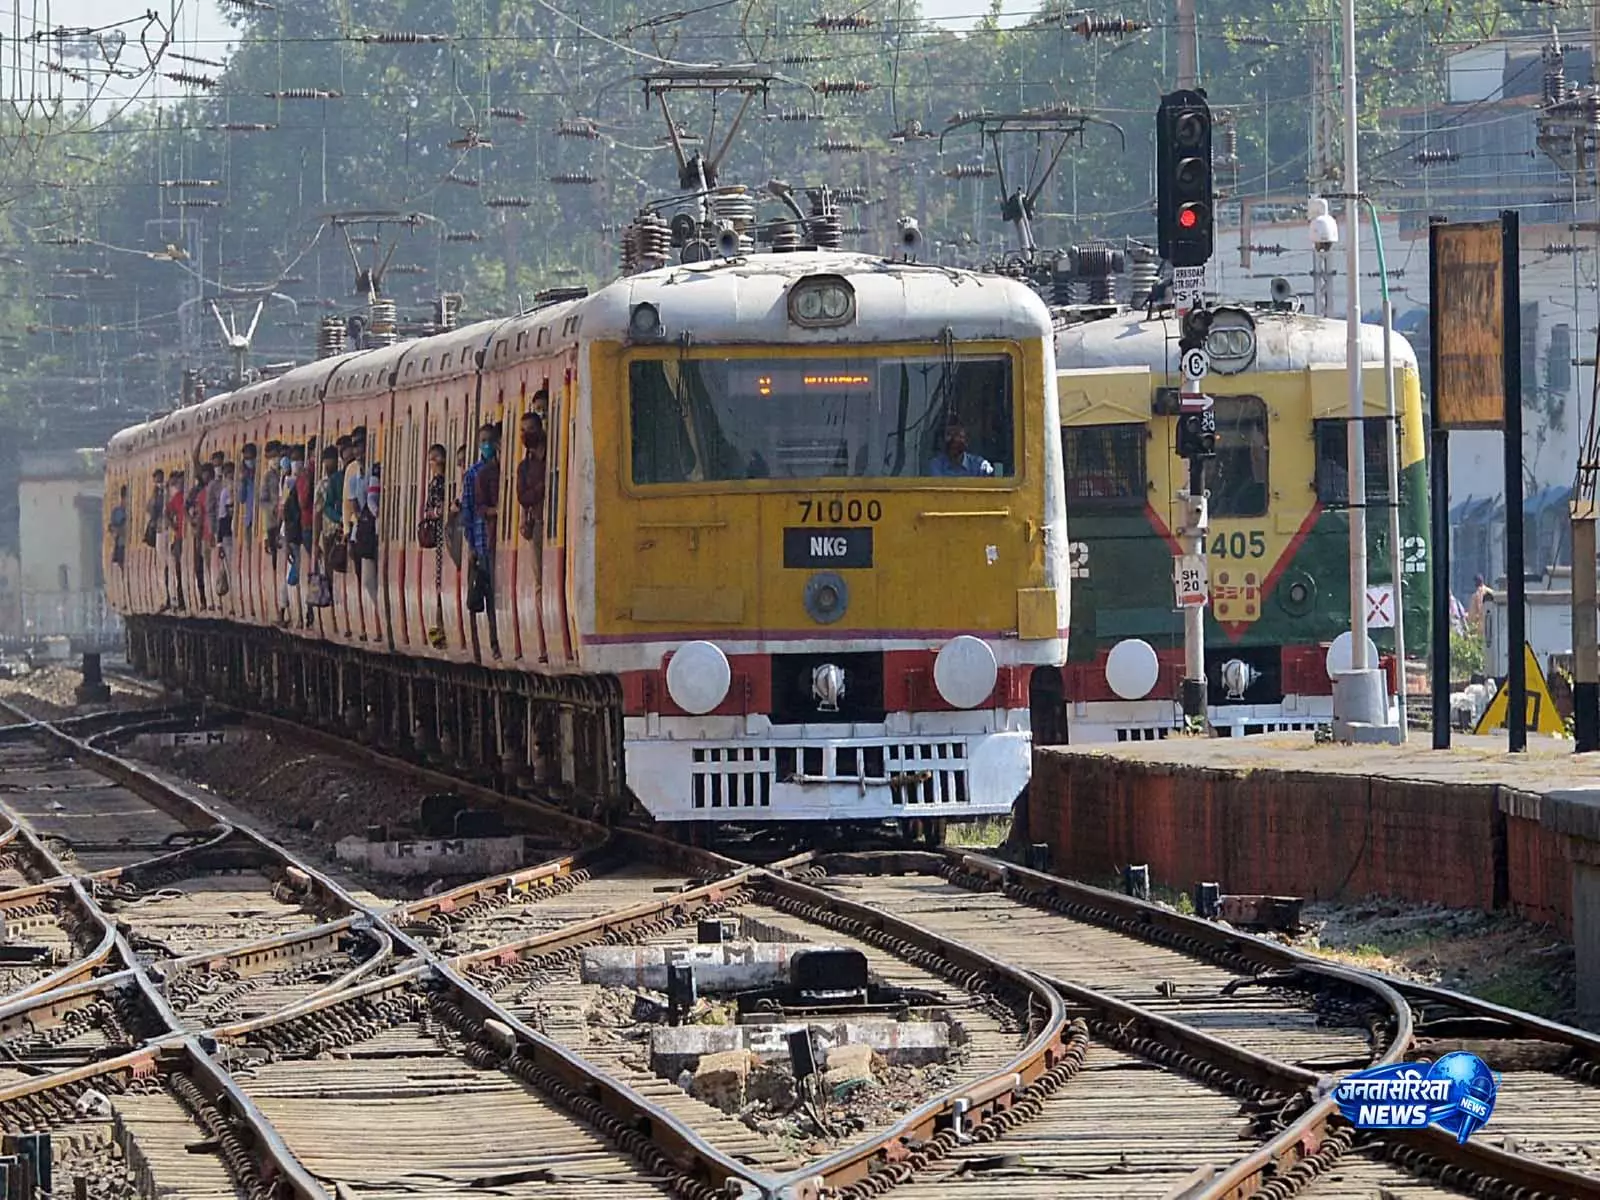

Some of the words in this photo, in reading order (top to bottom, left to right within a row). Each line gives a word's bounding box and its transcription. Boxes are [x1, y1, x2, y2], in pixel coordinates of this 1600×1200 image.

[797, 499, 882, 523] 71000
[810, 536, 848, 556] NKG
[1182, 570, 1199, 580] SH
[1183, 581, 1200, 592] 20
